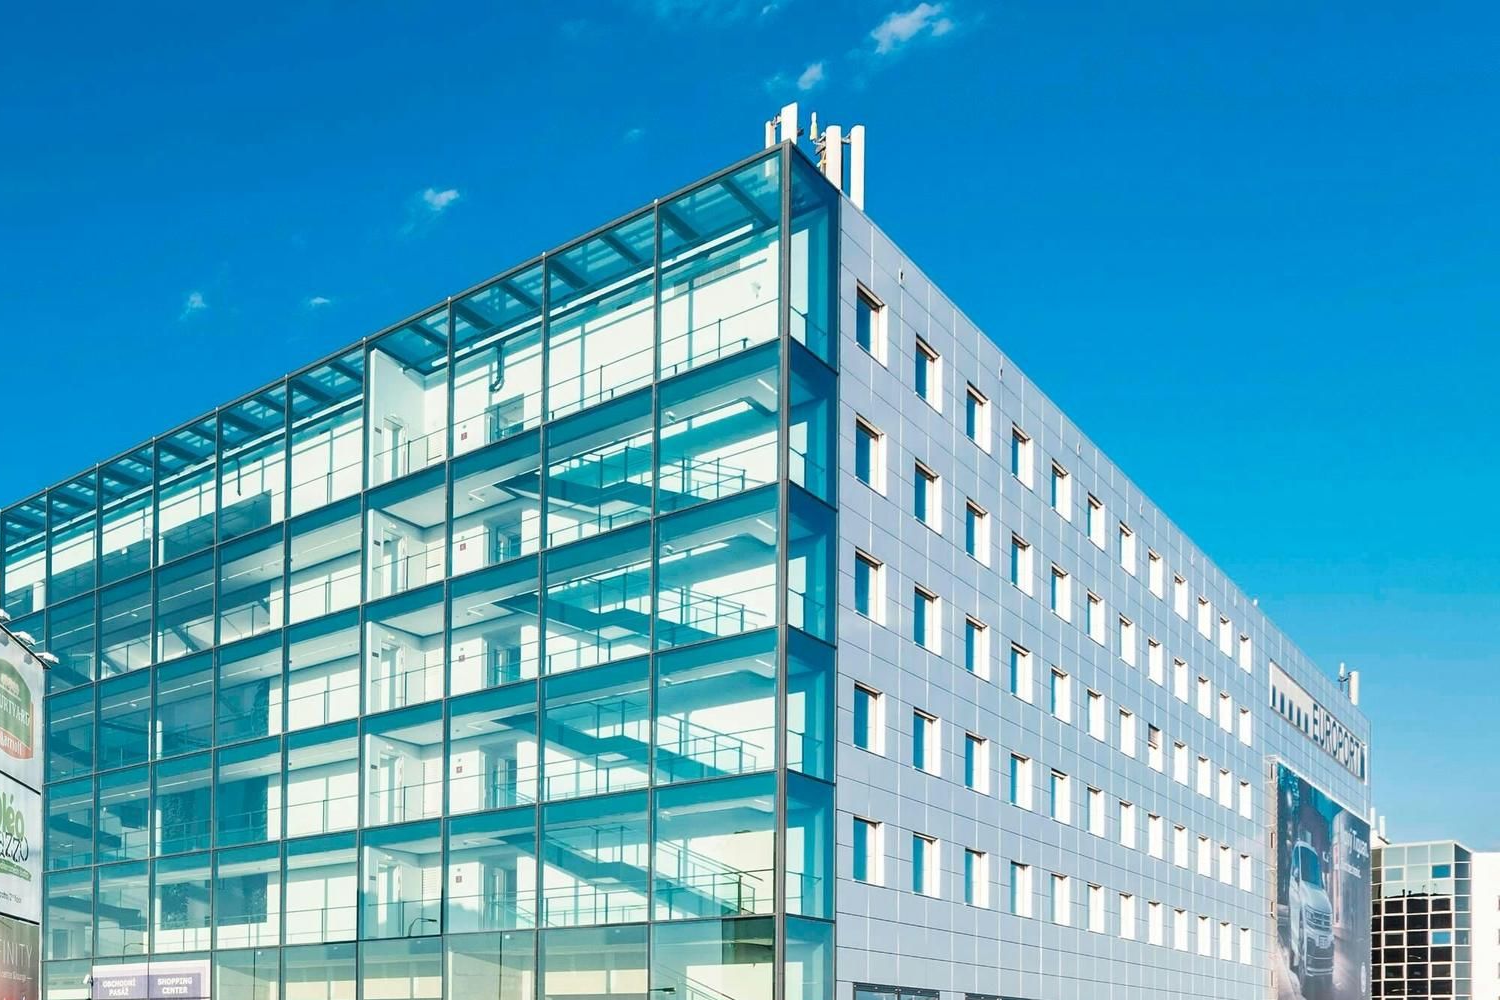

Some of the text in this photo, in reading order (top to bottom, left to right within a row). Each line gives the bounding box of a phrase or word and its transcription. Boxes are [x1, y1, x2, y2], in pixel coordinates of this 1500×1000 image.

[1313, 703, 1360, 778] EUROPORT
[157, 976, 193, 986] SHOPPING
[161, 986, 189, 995] CENTER
